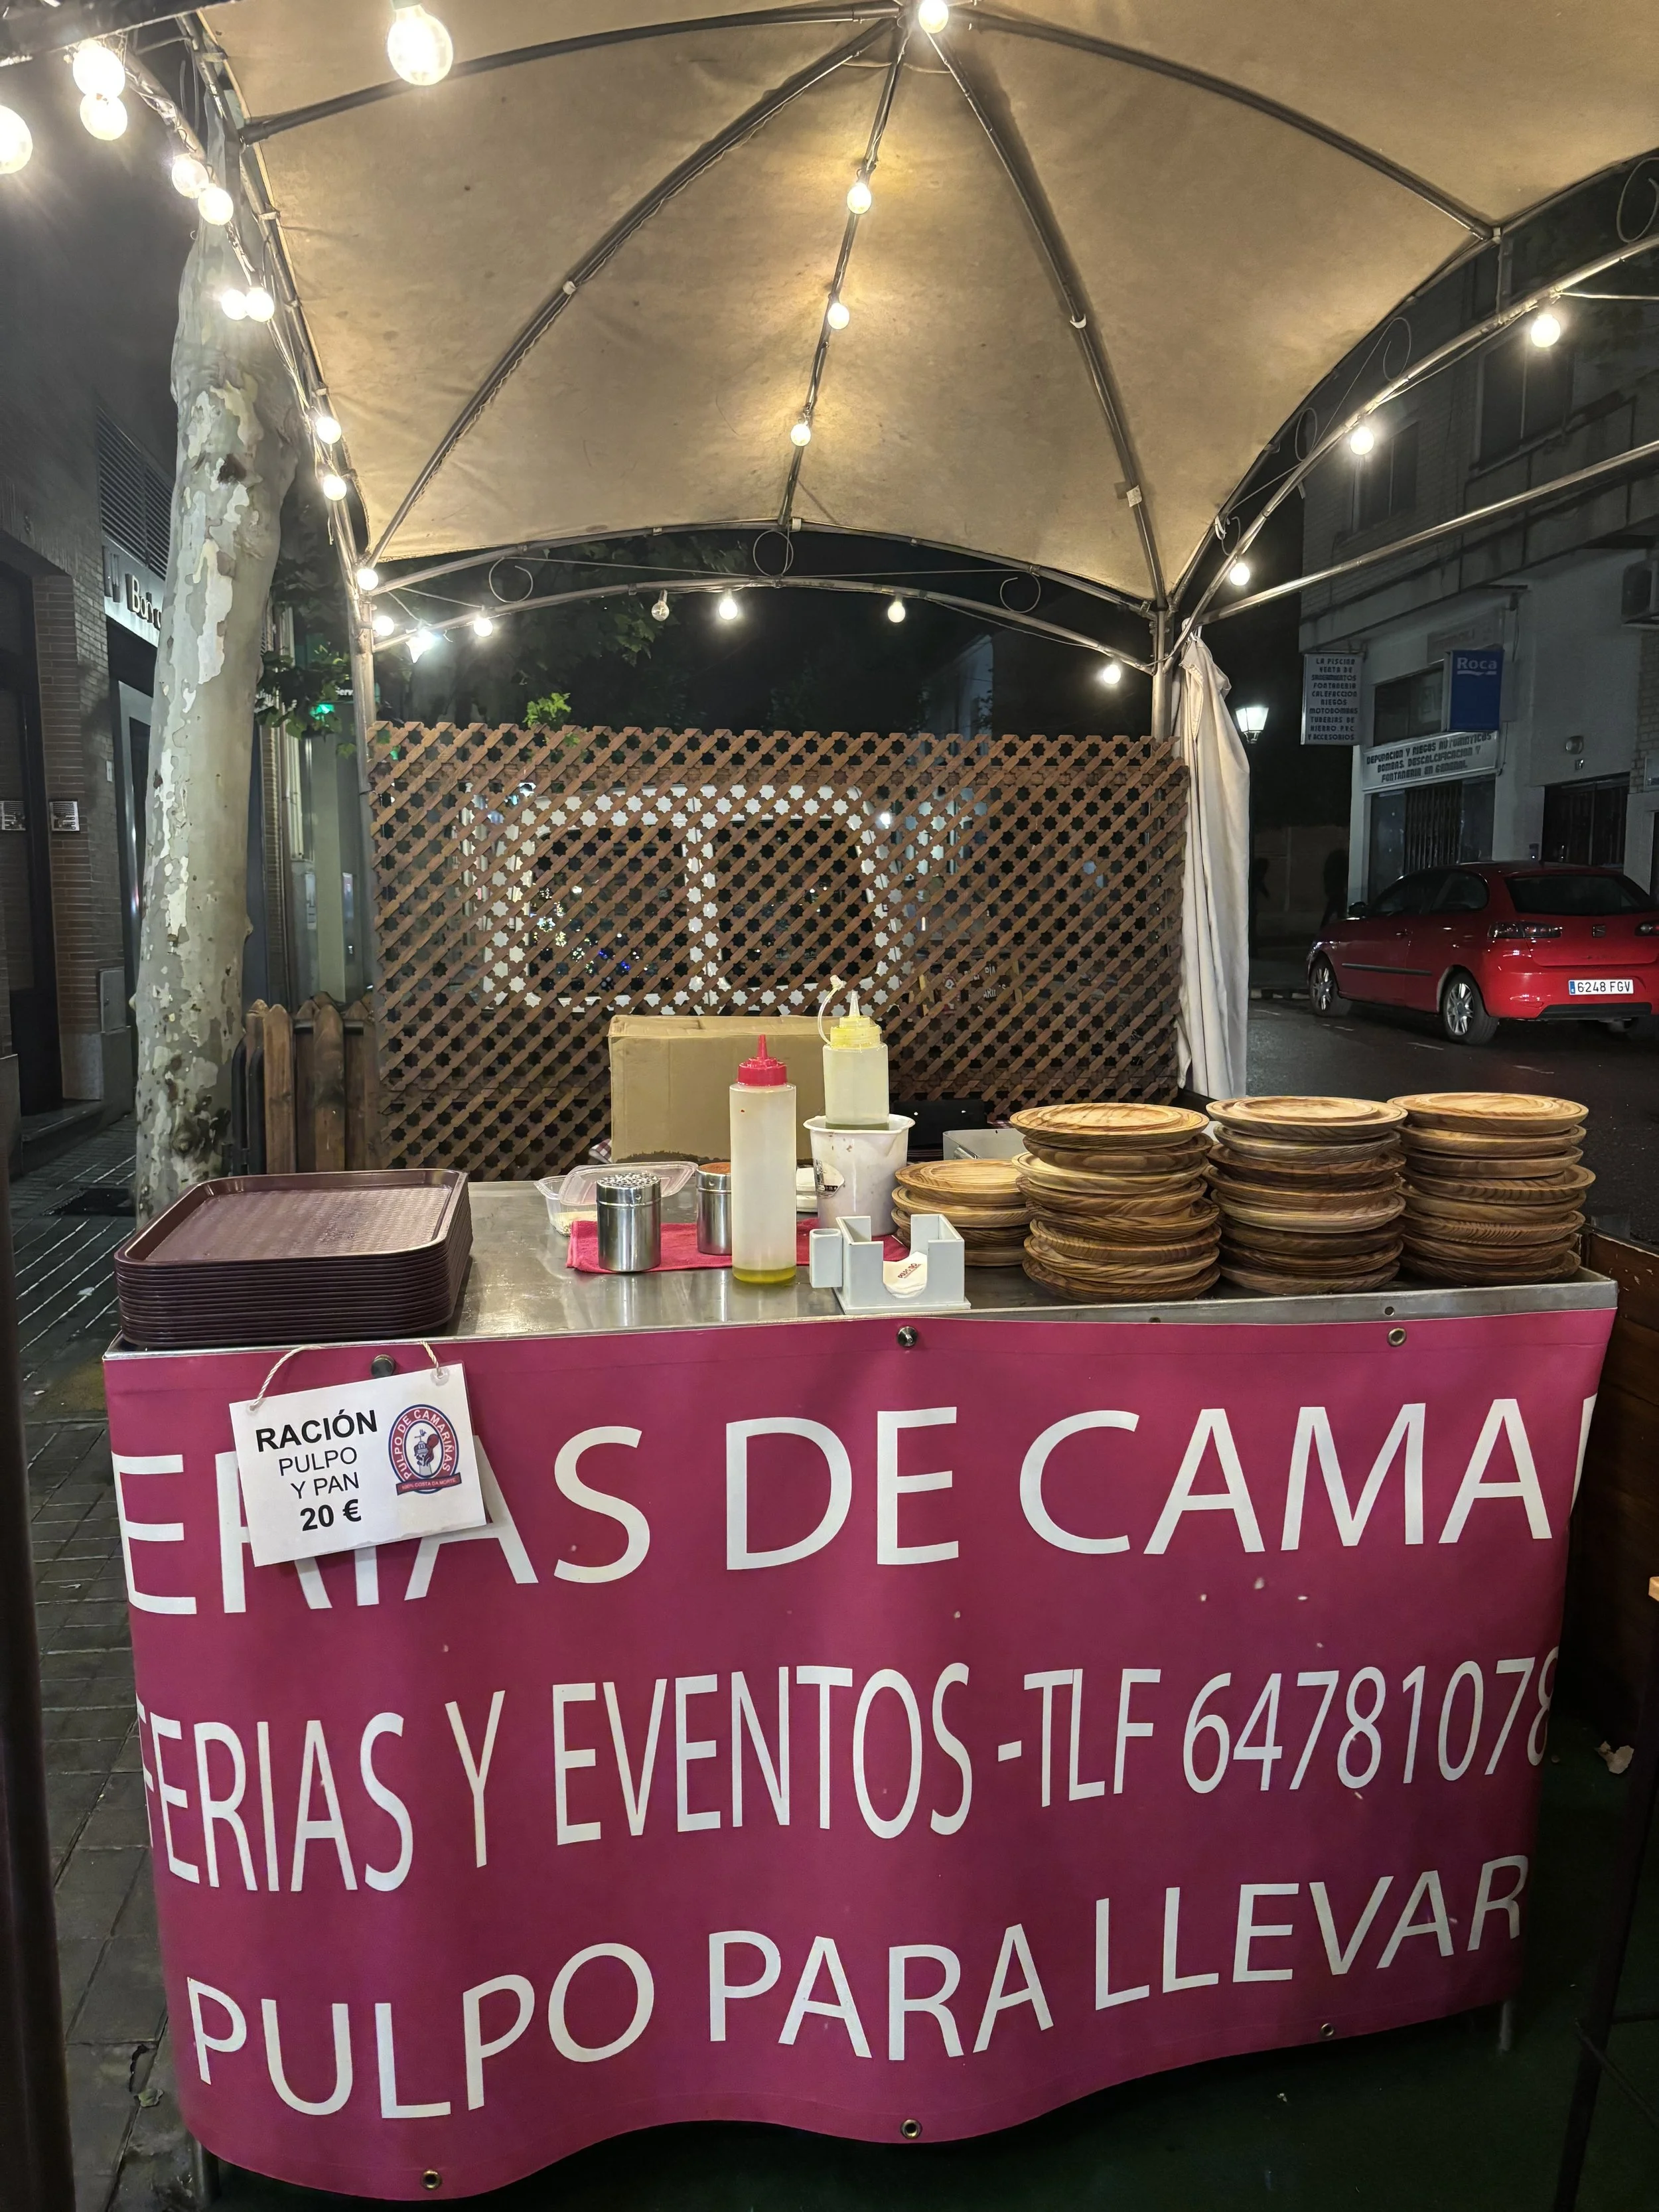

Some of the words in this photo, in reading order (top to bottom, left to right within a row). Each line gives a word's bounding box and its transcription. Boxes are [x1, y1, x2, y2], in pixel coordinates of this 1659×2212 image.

[1457, 657, 1497, 670] Roca
[1366, 749, 1404, 765] DEPURACION
[1406, 748, 1411, 757] Y
[1413, 742, 1436, 755] RIEGOS
[1577, 982, 1606, 992] 6248
[1609, 981, 1630, 992] FGV
[255, 1408, 378, 1452] RACIÓN
[397, 1415, 411, 1434] DE
[413, 1409, 455, 1471] CAMARIÑAS
[279, 1447, 357, 1476] PULPO
[394, 1436, 412, 1480] PULPO
[290, 1481, 306, 1499] Y
[313, 1471, 360, 1496] PAN
[726, 1407, 958, 1570] DE
[1020, 1394, 1597, 1554] CAMA
[300, 1504, 334, 1532] 20
[342, 1499, 362, 1522] €
[445, 1690, 505, 1868] Y
[553, 1662, 972, 1845] EVENTOS
[187, 1943, 654, 2118] PULPO
[709, 1924, 1053, 2060] PARA
[1096, 1855, 1529, 2010] LLEVAR
